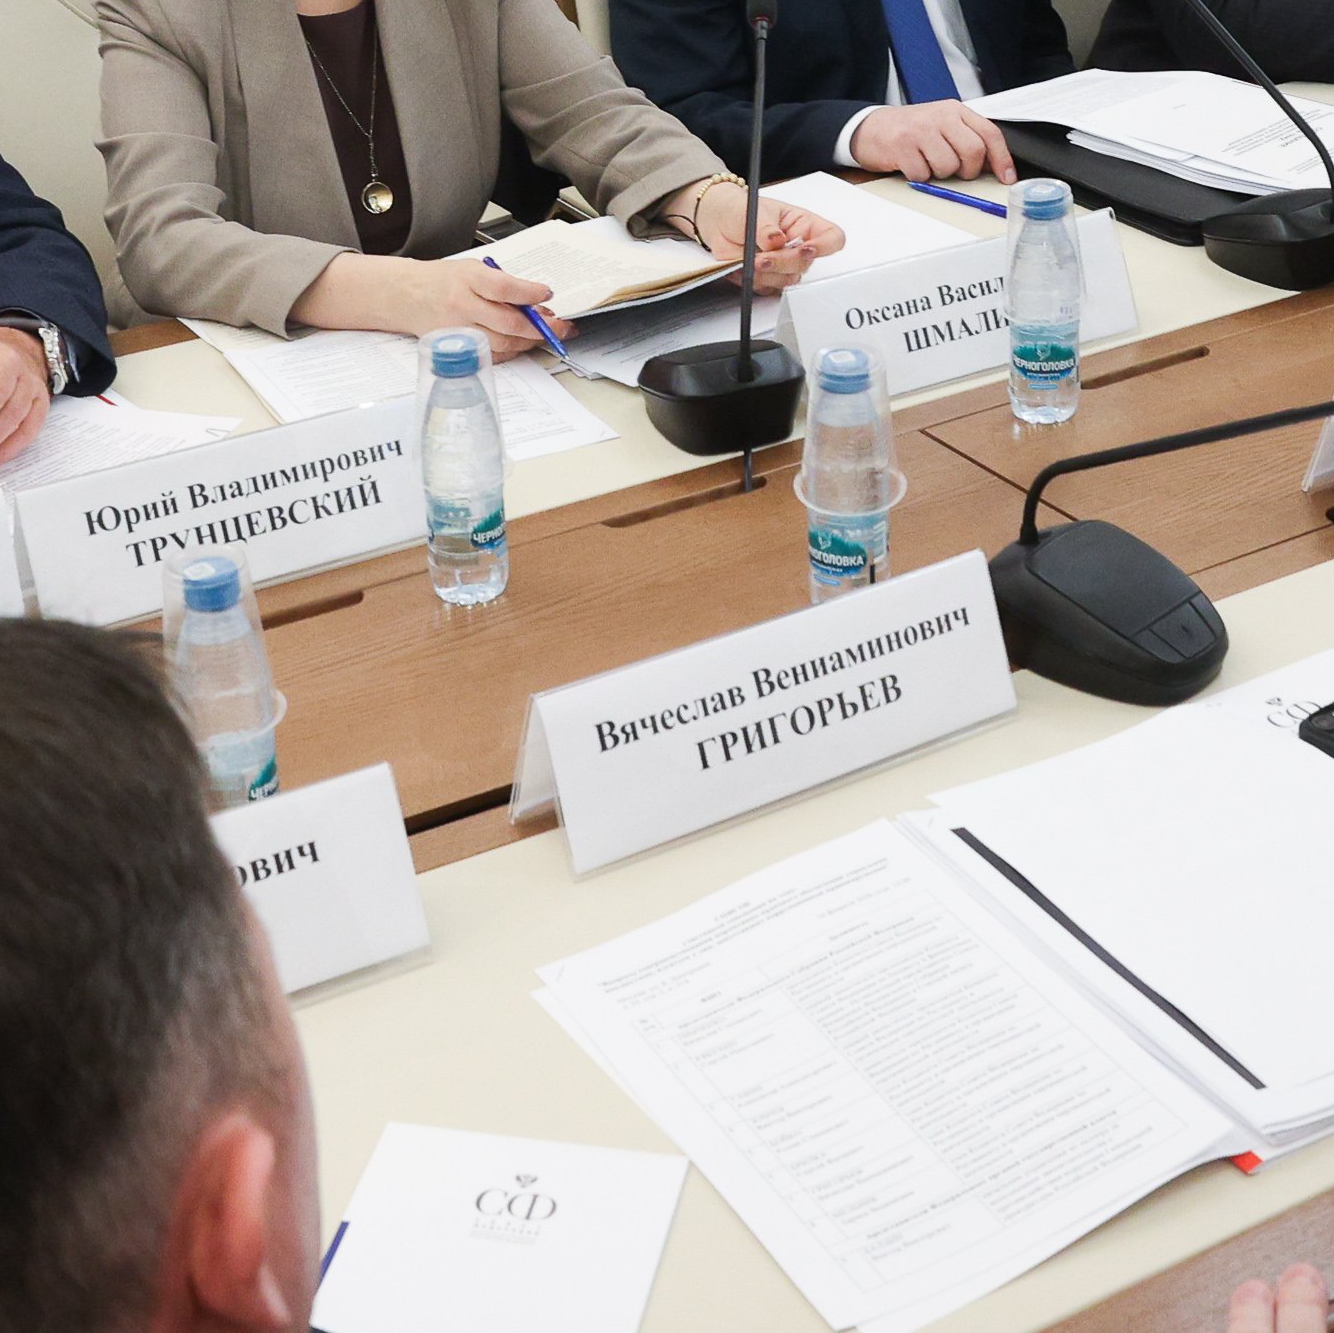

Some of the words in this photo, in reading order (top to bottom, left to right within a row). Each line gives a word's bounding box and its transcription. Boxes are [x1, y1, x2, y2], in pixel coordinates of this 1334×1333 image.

[845, 295, 932, 330] Оксана
[937, 276, 1005, 307] Васил
[84, 491, 179, 536] Юрий
[186, 439, 404, 510] Владимирович
[125, 474, 384, 568] ТРУНЦЕВСКИЙ
[594, 684, 746, 753] Вячеслав
[751, 606, 971, 699] Вениаминович
[695, 673, 903, 771] ГРИГОРЬЕВ
